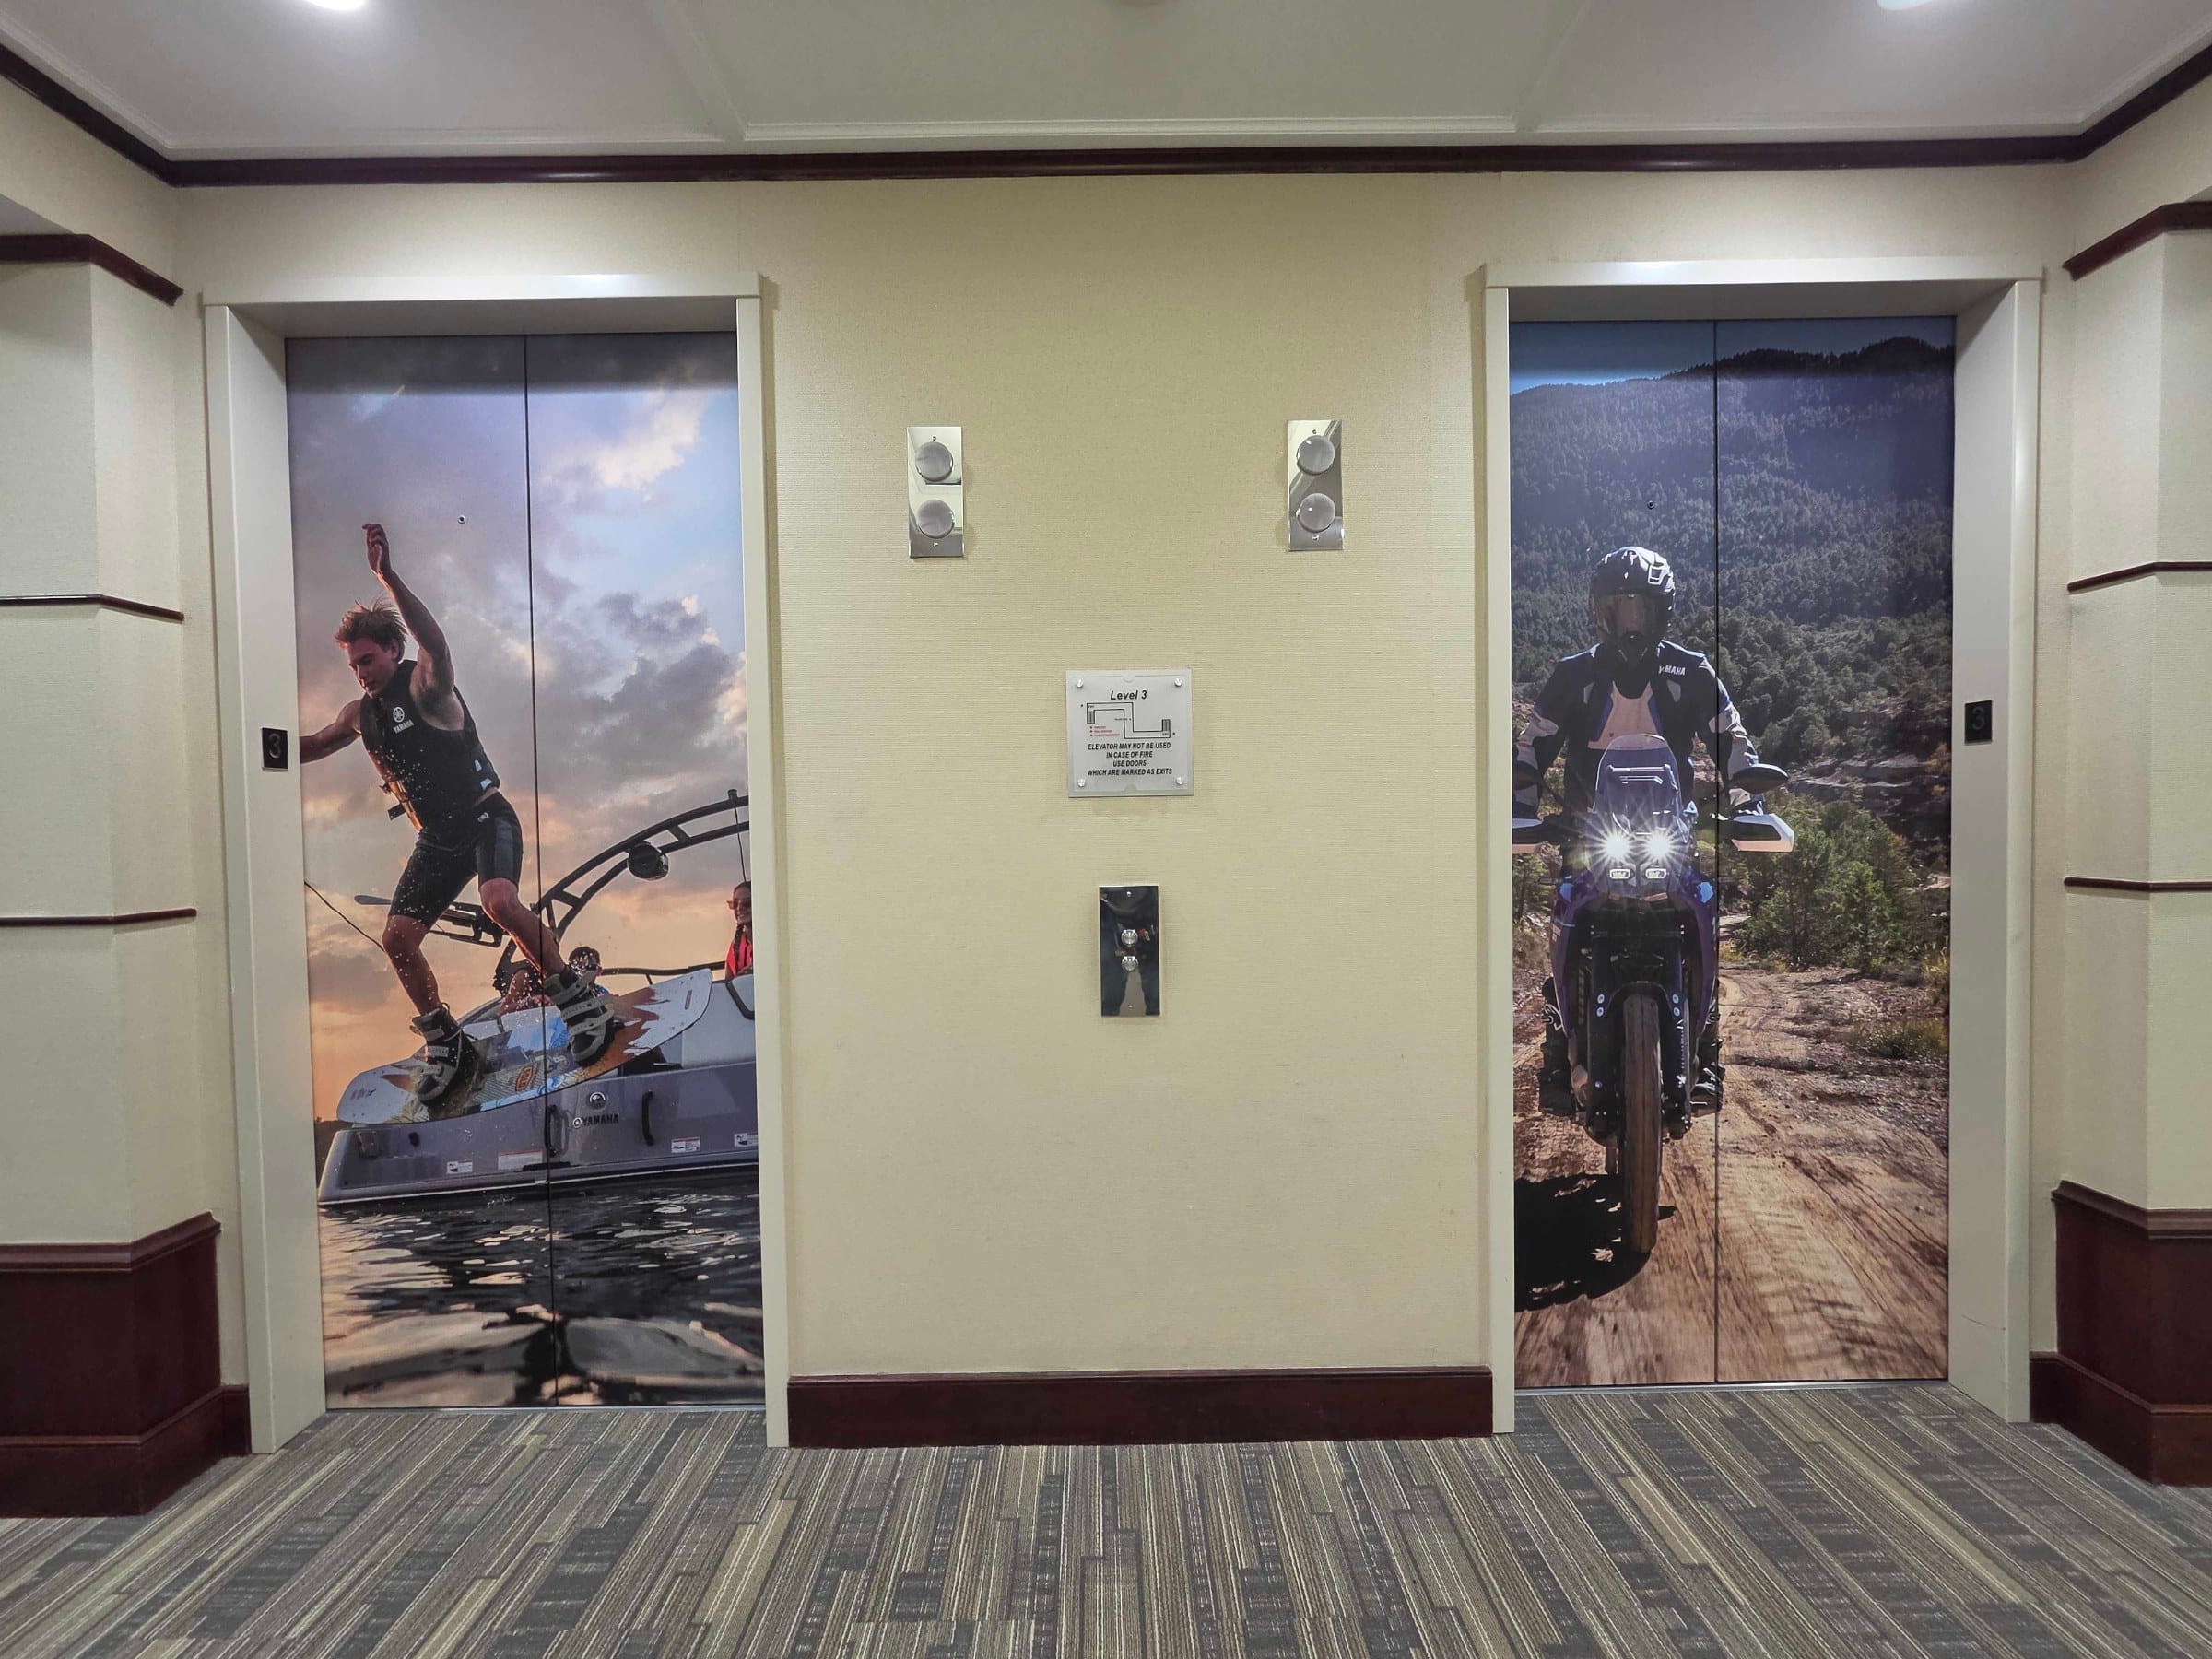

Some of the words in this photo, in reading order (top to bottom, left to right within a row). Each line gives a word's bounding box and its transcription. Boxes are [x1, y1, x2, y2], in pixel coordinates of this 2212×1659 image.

[1111, 690, 1138, 700] Level
[1141, 689, 1147, 700] 3
[1972, 706, 1985, 730] 3
[268, 733, 281, 759] 3
[582, 1113, 619, 1126] YAMAHA
